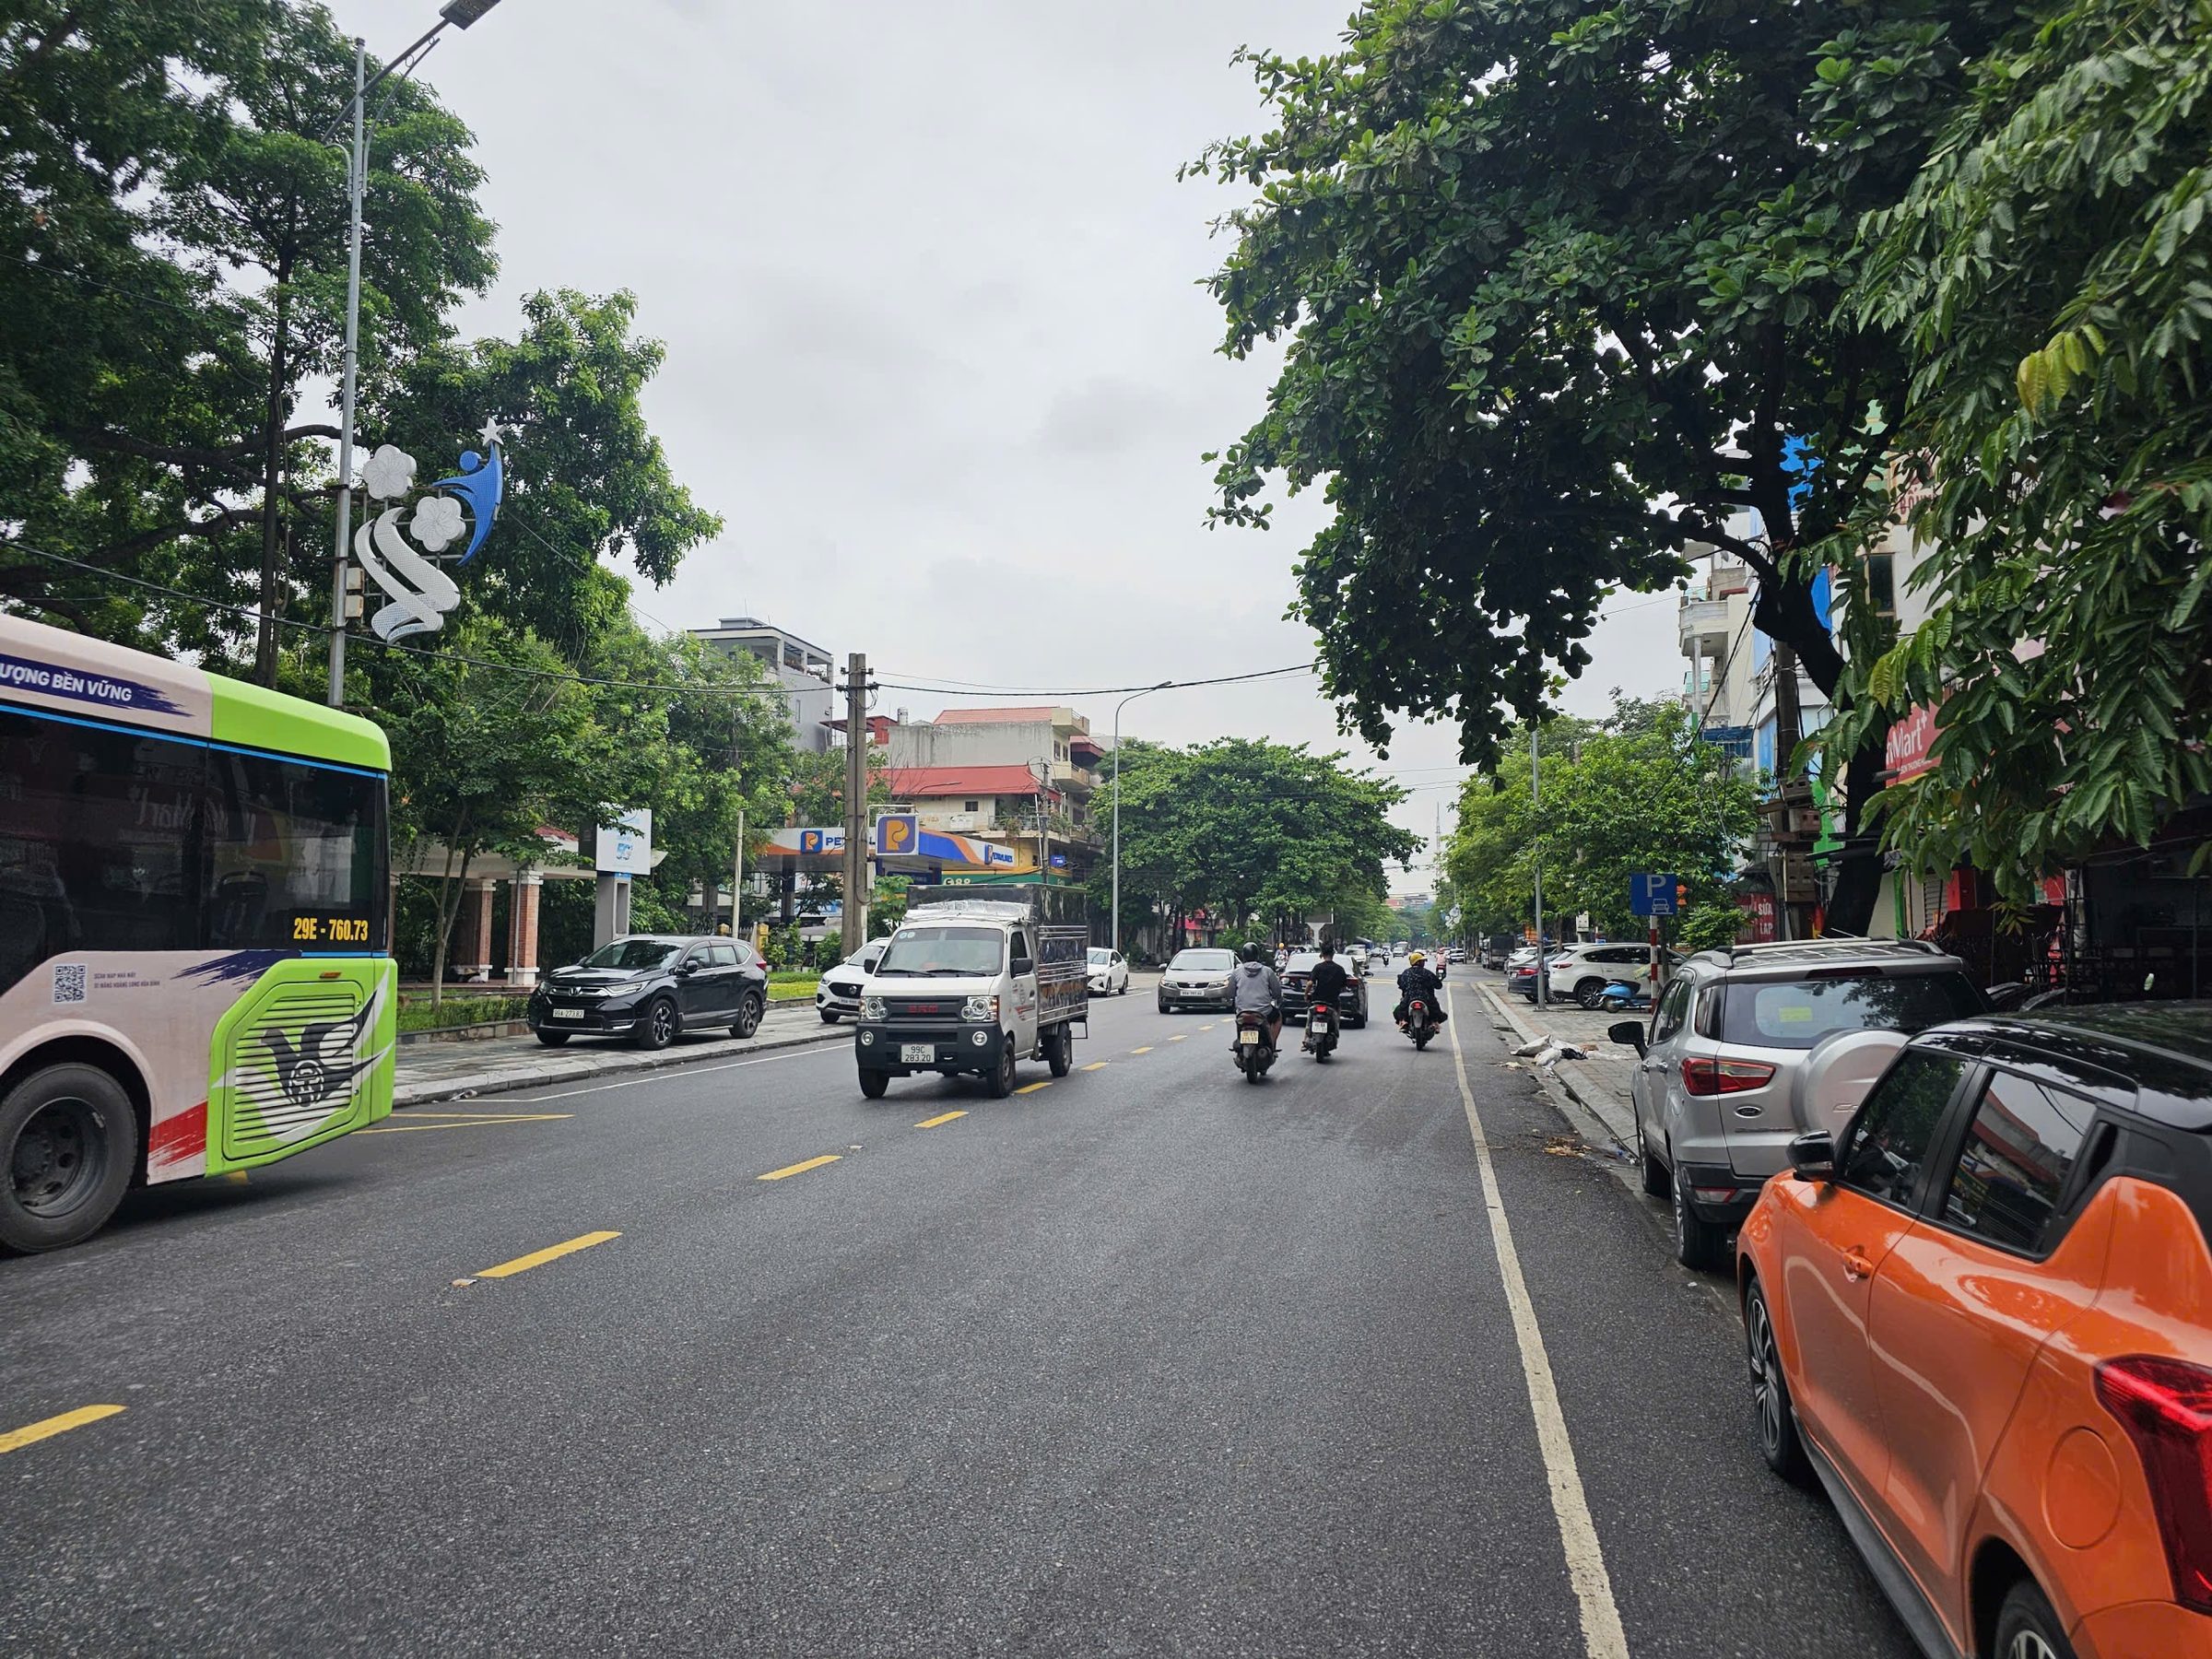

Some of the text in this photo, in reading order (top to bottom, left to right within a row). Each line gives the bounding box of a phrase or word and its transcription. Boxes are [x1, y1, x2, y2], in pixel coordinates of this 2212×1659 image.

[52, 671, 85, 693] BỀN
[87, 680, 133, 702] VỮNG
[1646, 874, 1666, 898] P
[293, 917, 317, 939] 29E
[328, 919, 369, 941] 760.73
[911, 1045, 925, 1054] 99C
